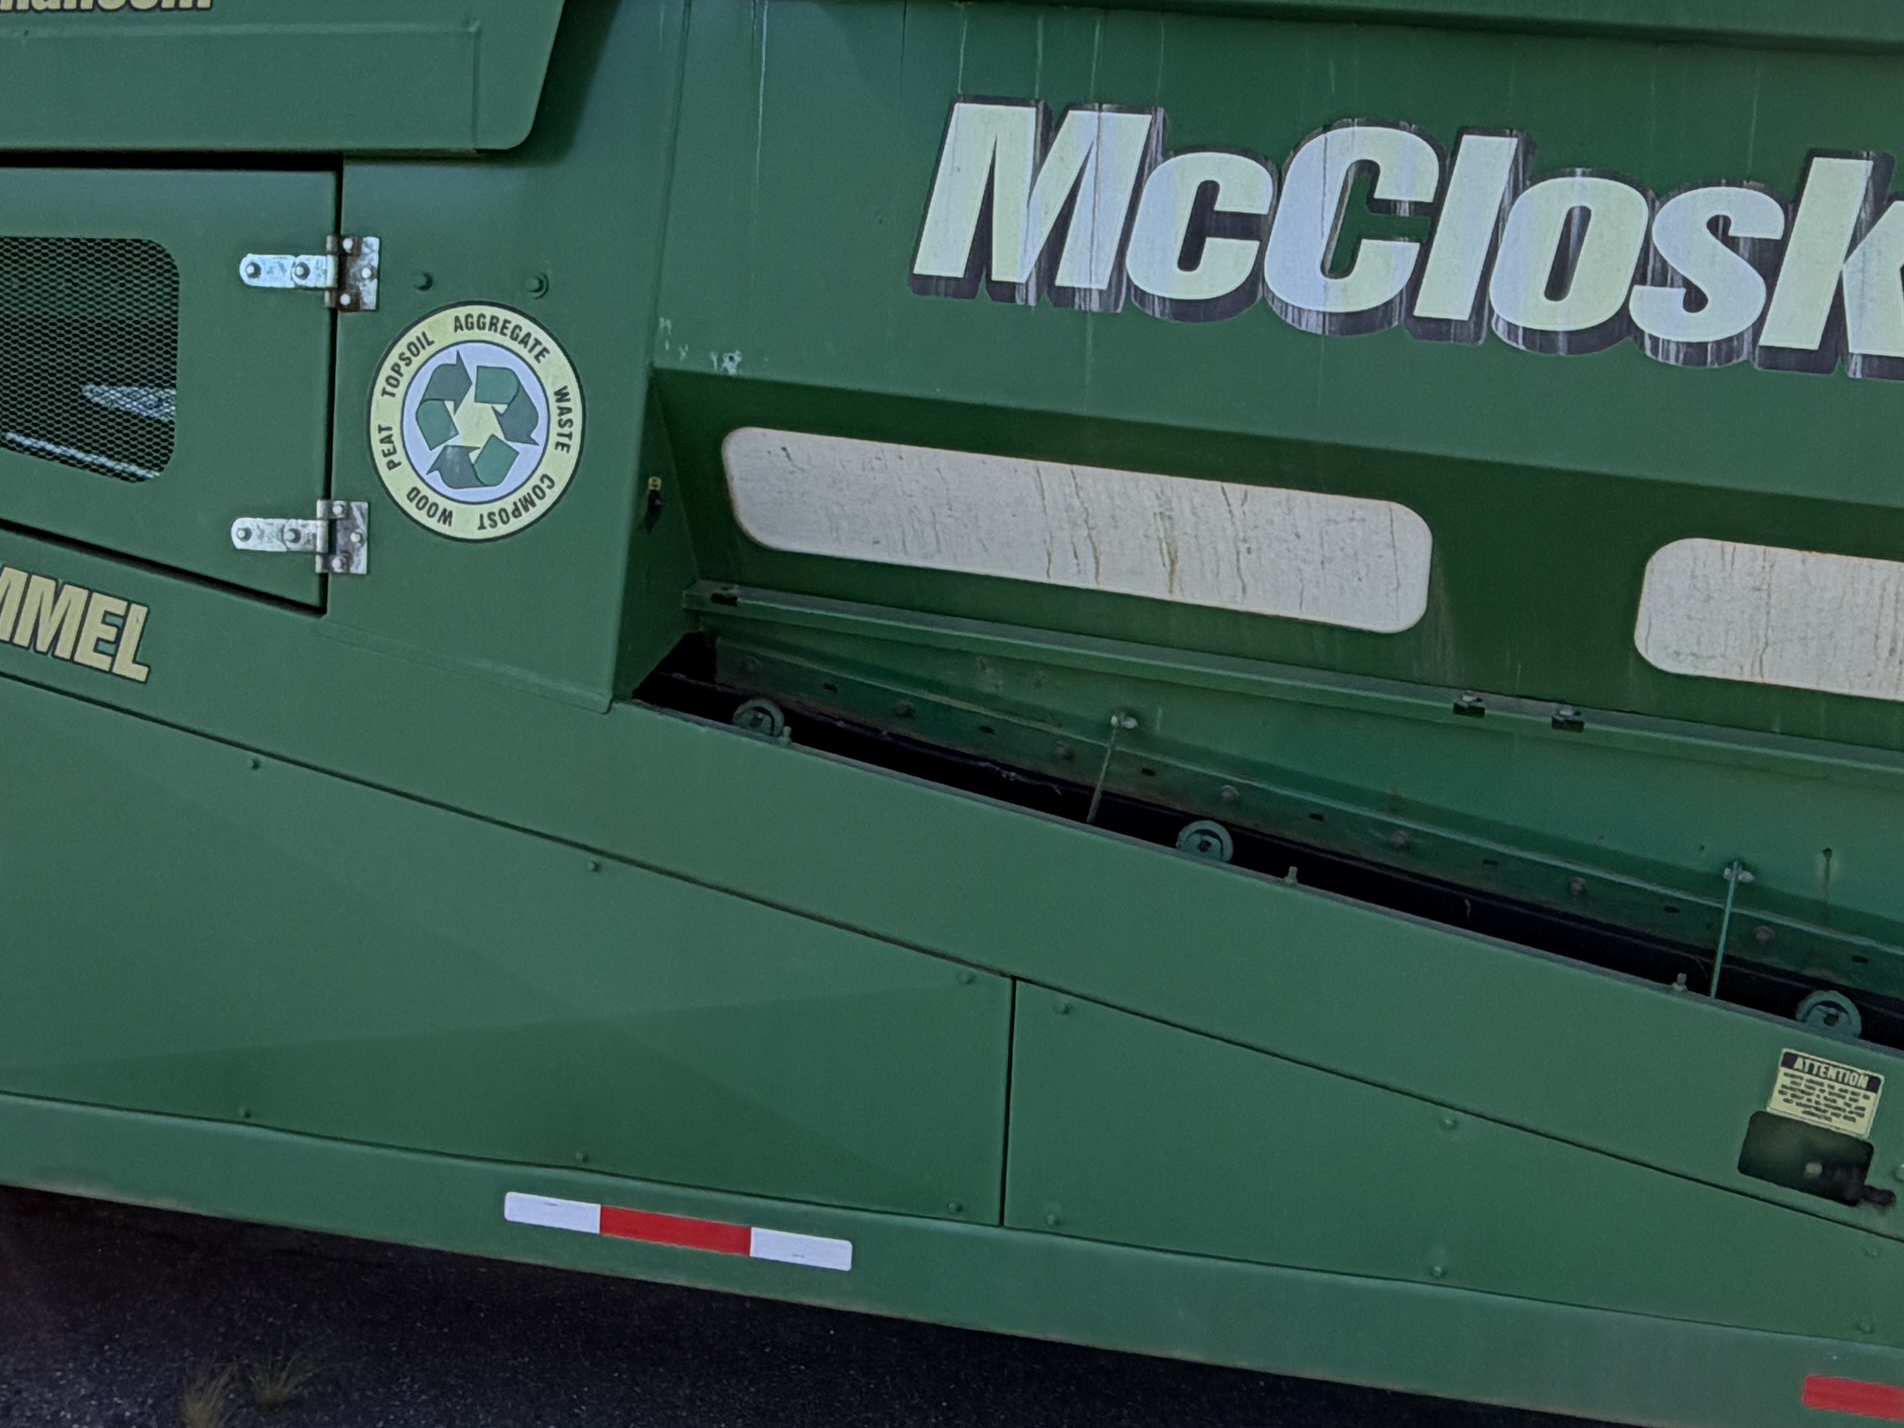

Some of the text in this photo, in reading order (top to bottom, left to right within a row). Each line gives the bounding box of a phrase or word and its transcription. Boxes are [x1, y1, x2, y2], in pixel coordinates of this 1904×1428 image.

[377, 313, 574, 531] AGGREGATE WASTE COMPOST WOOD PEAT TOPSOIL
[1792, 1056, 1870, 1090] ATTENTION
